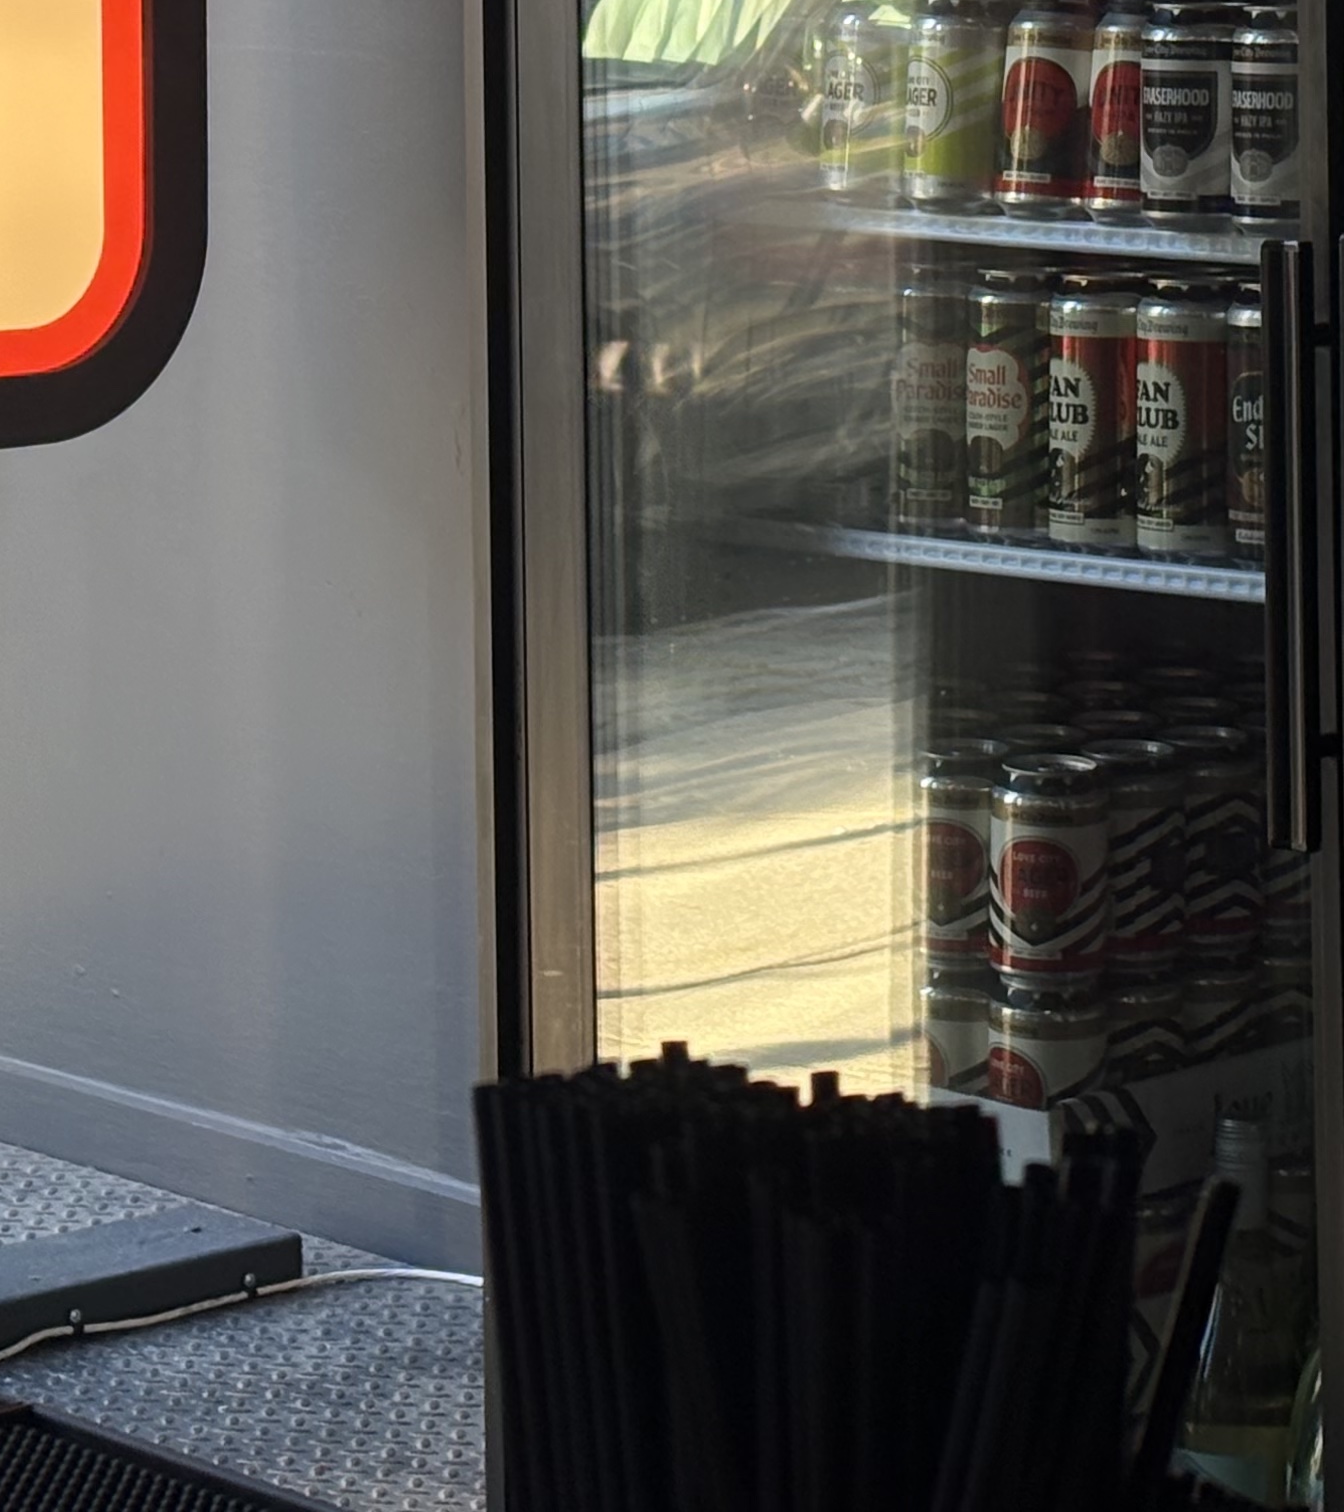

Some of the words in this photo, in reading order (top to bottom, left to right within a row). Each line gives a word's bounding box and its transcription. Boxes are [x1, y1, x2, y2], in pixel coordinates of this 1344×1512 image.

[827, 80, 865, 102] AGER
[907, 88, 937, 107] AGER
[968, 363, 1007, 386] Small
[968, 386, 1023, 409] aradise
[1050, 375, 1082, 398] AN
[1050, 401, 1089, 425] LUB
[1138, 406, 1180, 430] LUB
[1232, 394, 1264, 423] End
[1061, 430, 1078, 443] ALE
[1150, 433, 1168, 447] ALE
